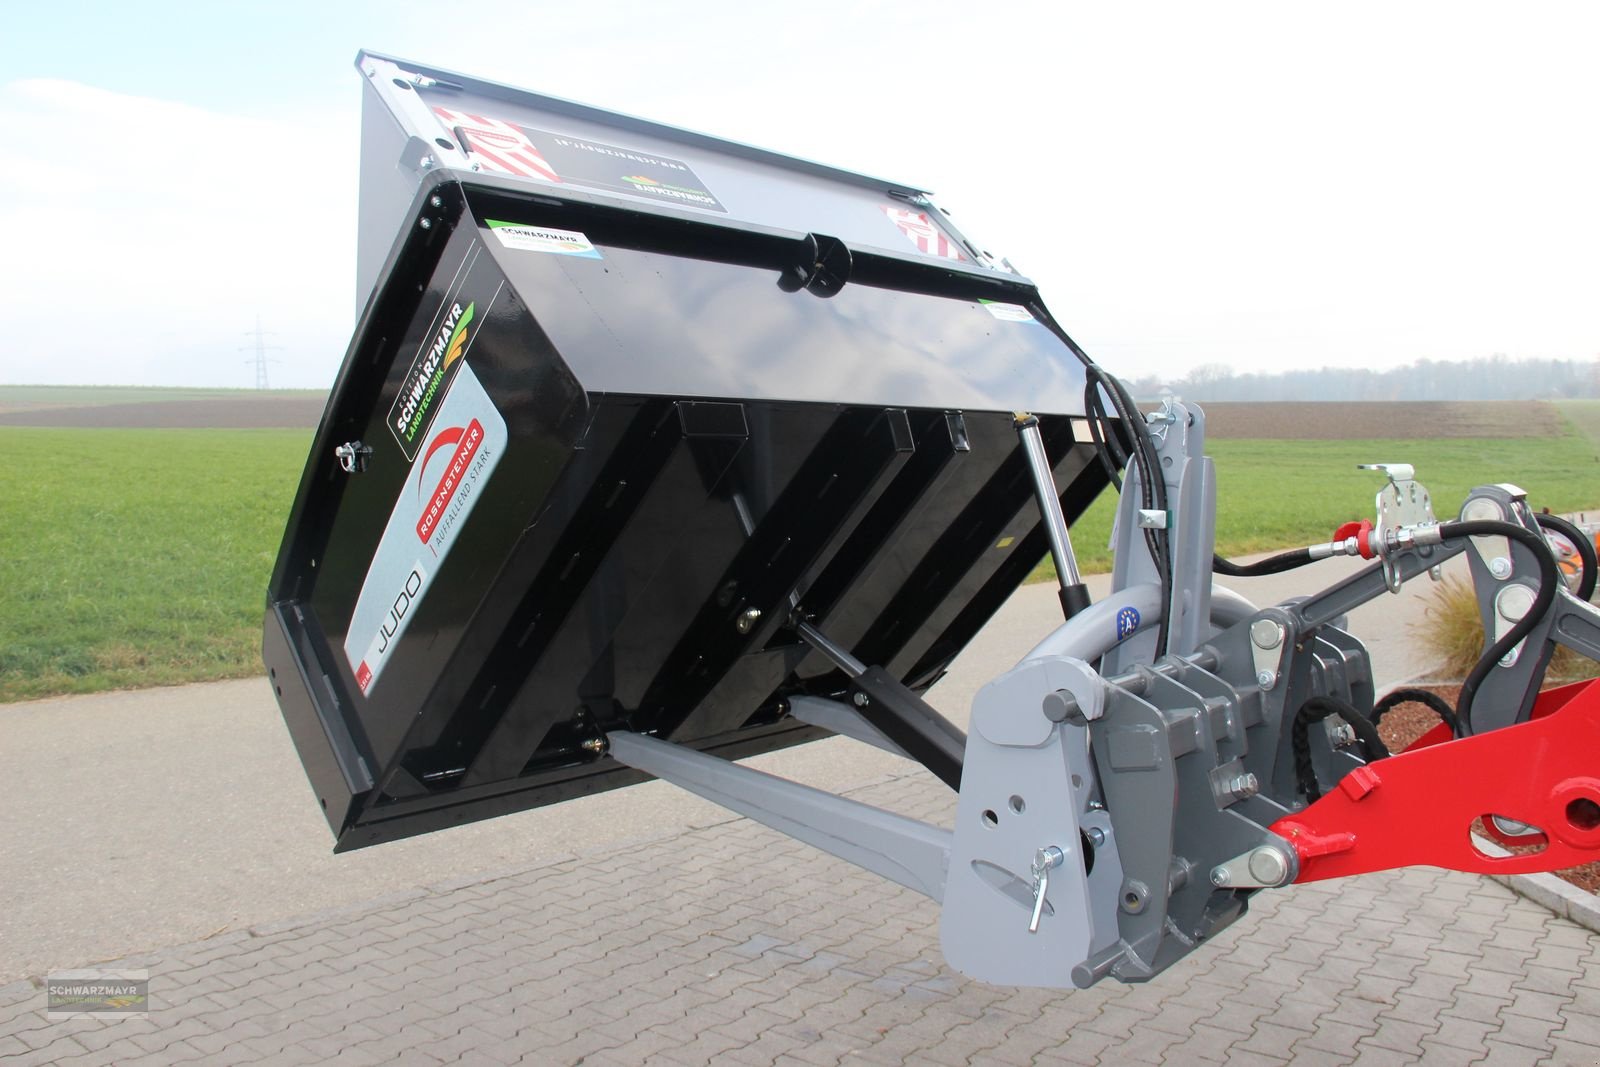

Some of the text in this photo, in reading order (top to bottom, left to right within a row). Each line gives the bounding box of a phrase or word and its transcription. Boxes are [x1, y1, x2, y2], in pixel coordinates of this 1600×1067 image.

[501, 227, 578, 243] SCHWARZMAYR
[397, 302, 464, 434] SCHWARZMAYR
[399, 362, 423, 409] EDITION
[405, 368, 445, 443] LANDTECHNIK
[420, 427, 479, 536] ROSENSTEINER
[435, 446, 492, 547] AUFFALLEND STARK
[378, 570, 421, 654] JUDO
[1125, 616, 1132, 633] A
